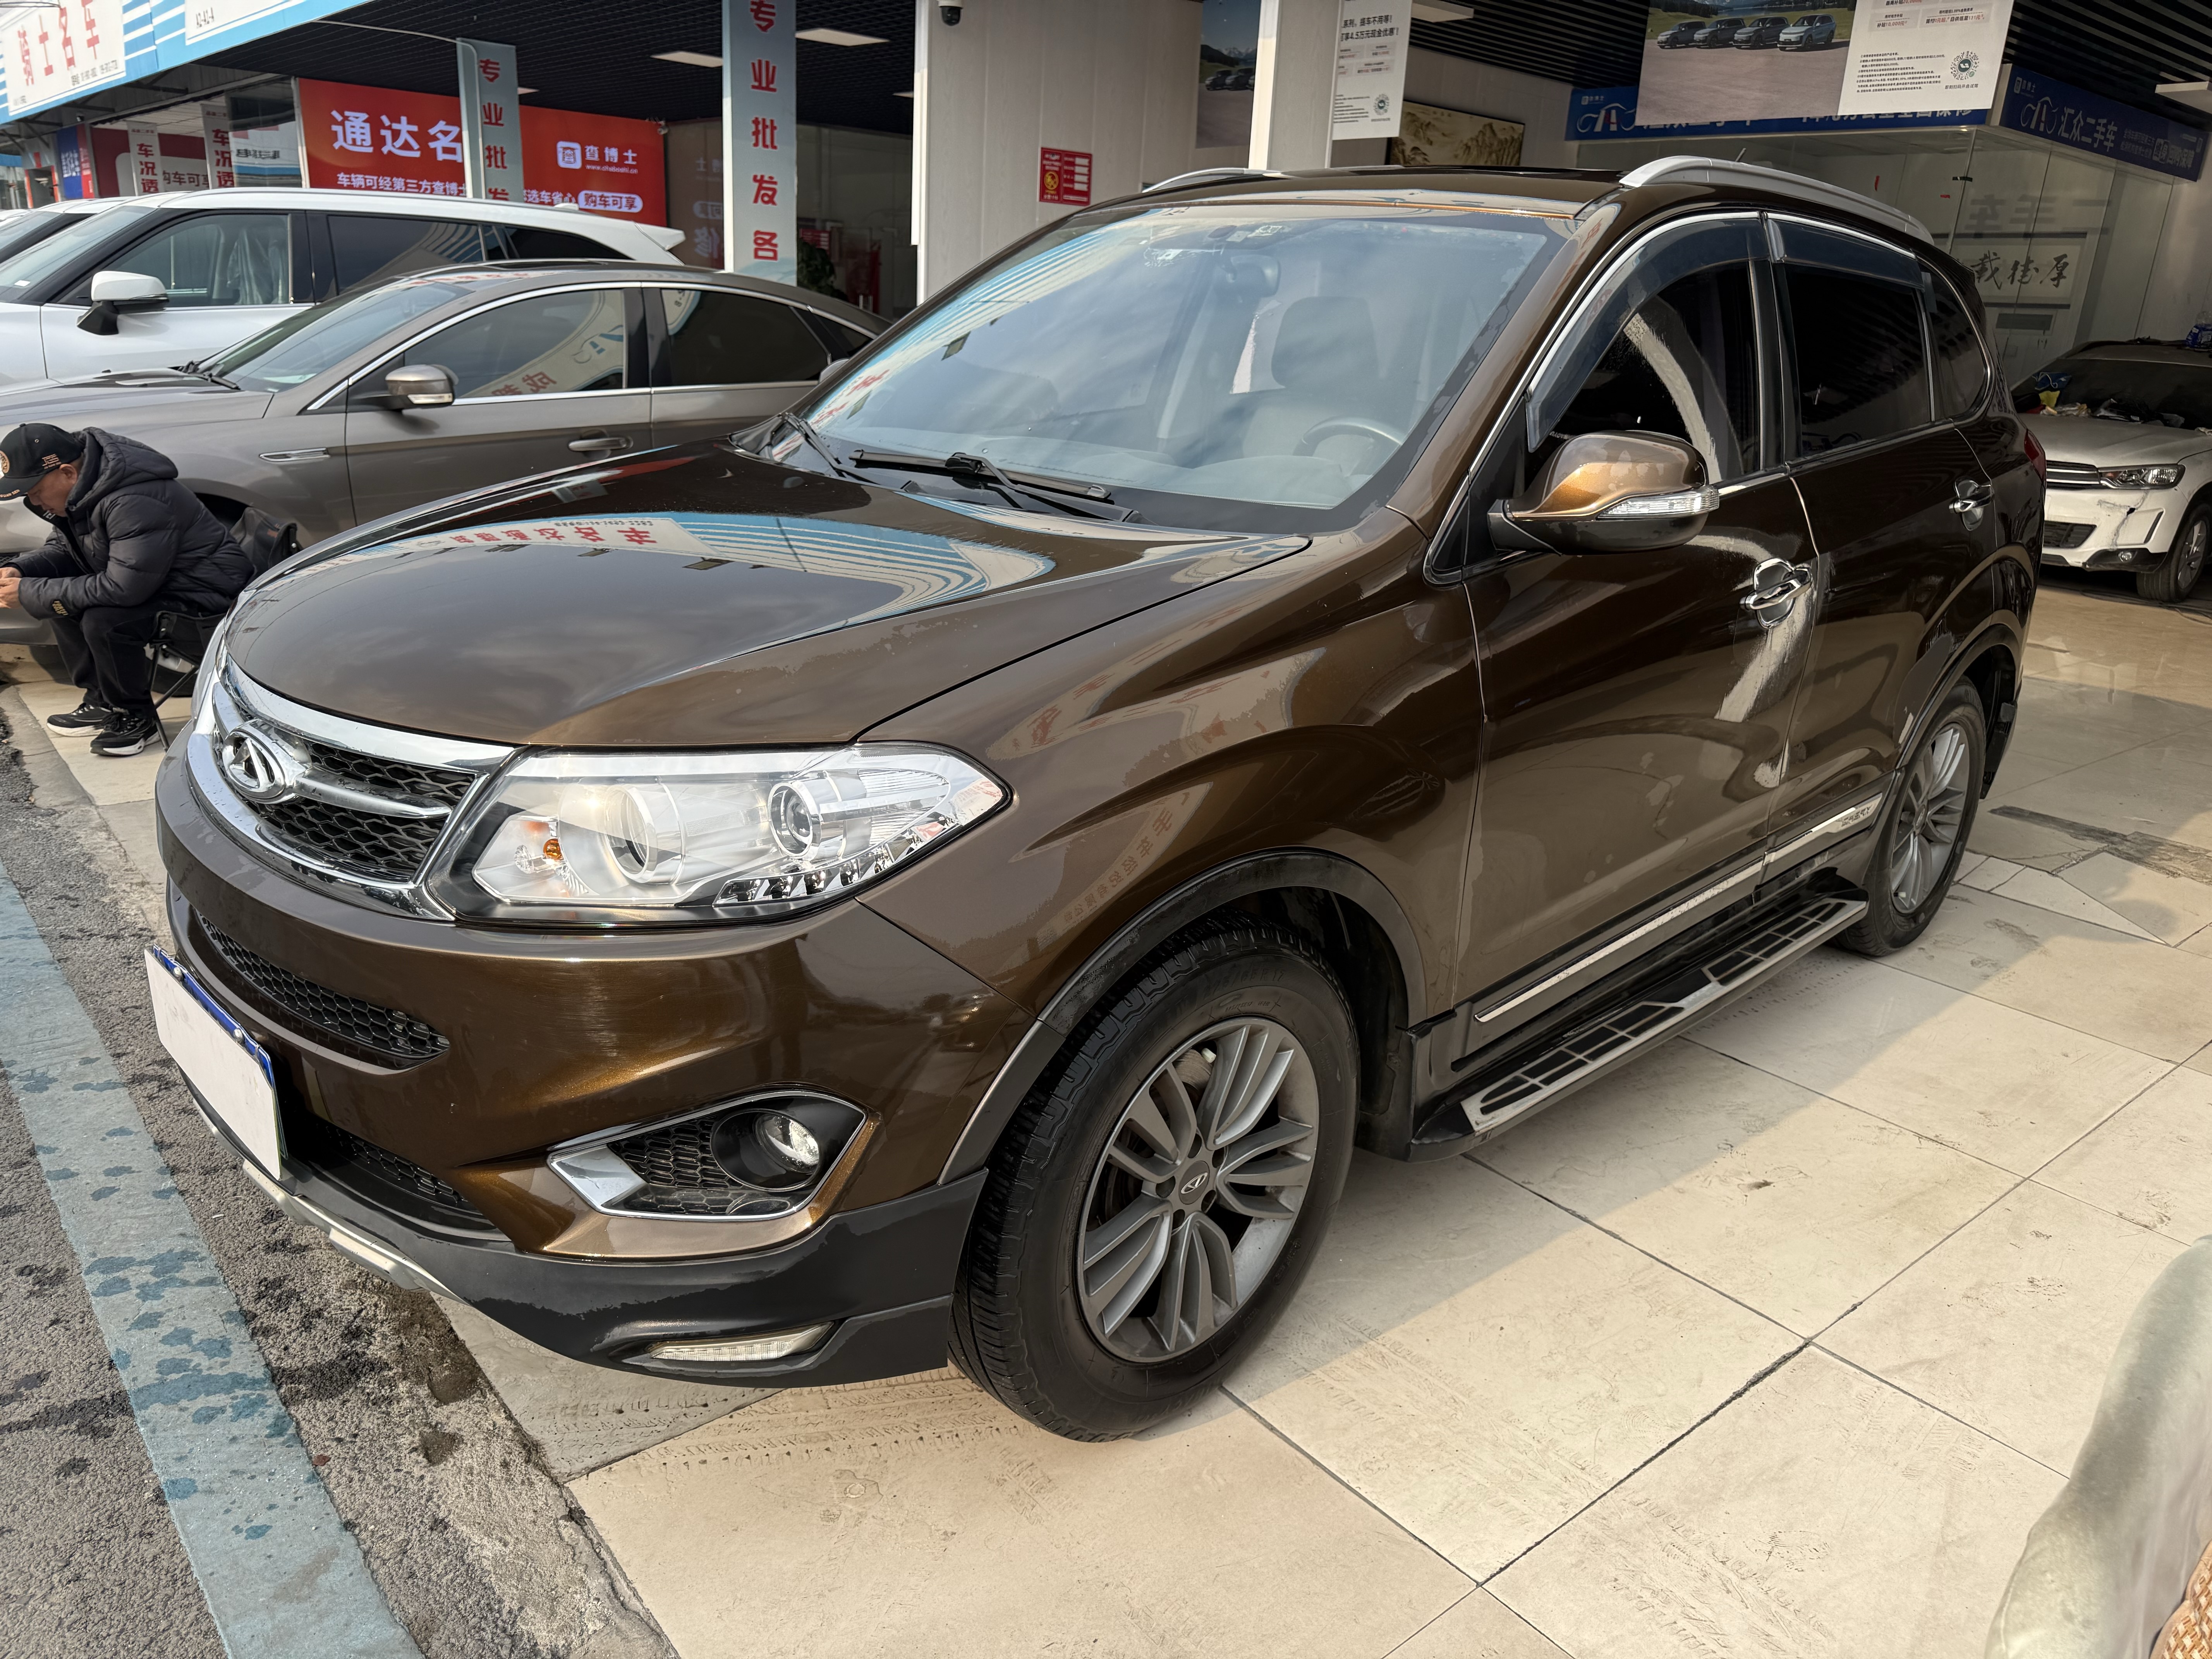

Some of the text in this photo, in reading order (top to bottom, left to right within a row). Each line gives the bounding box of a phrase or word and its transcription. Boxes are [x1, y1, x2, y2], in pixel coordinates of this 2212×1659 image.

[331, 110, 463, 163] 通达名
[2058, 106, 2118, 152] 汇众二手车
[585, 145, 637, 165] 查博士
[584, 193, 637, 211] 购车可享
